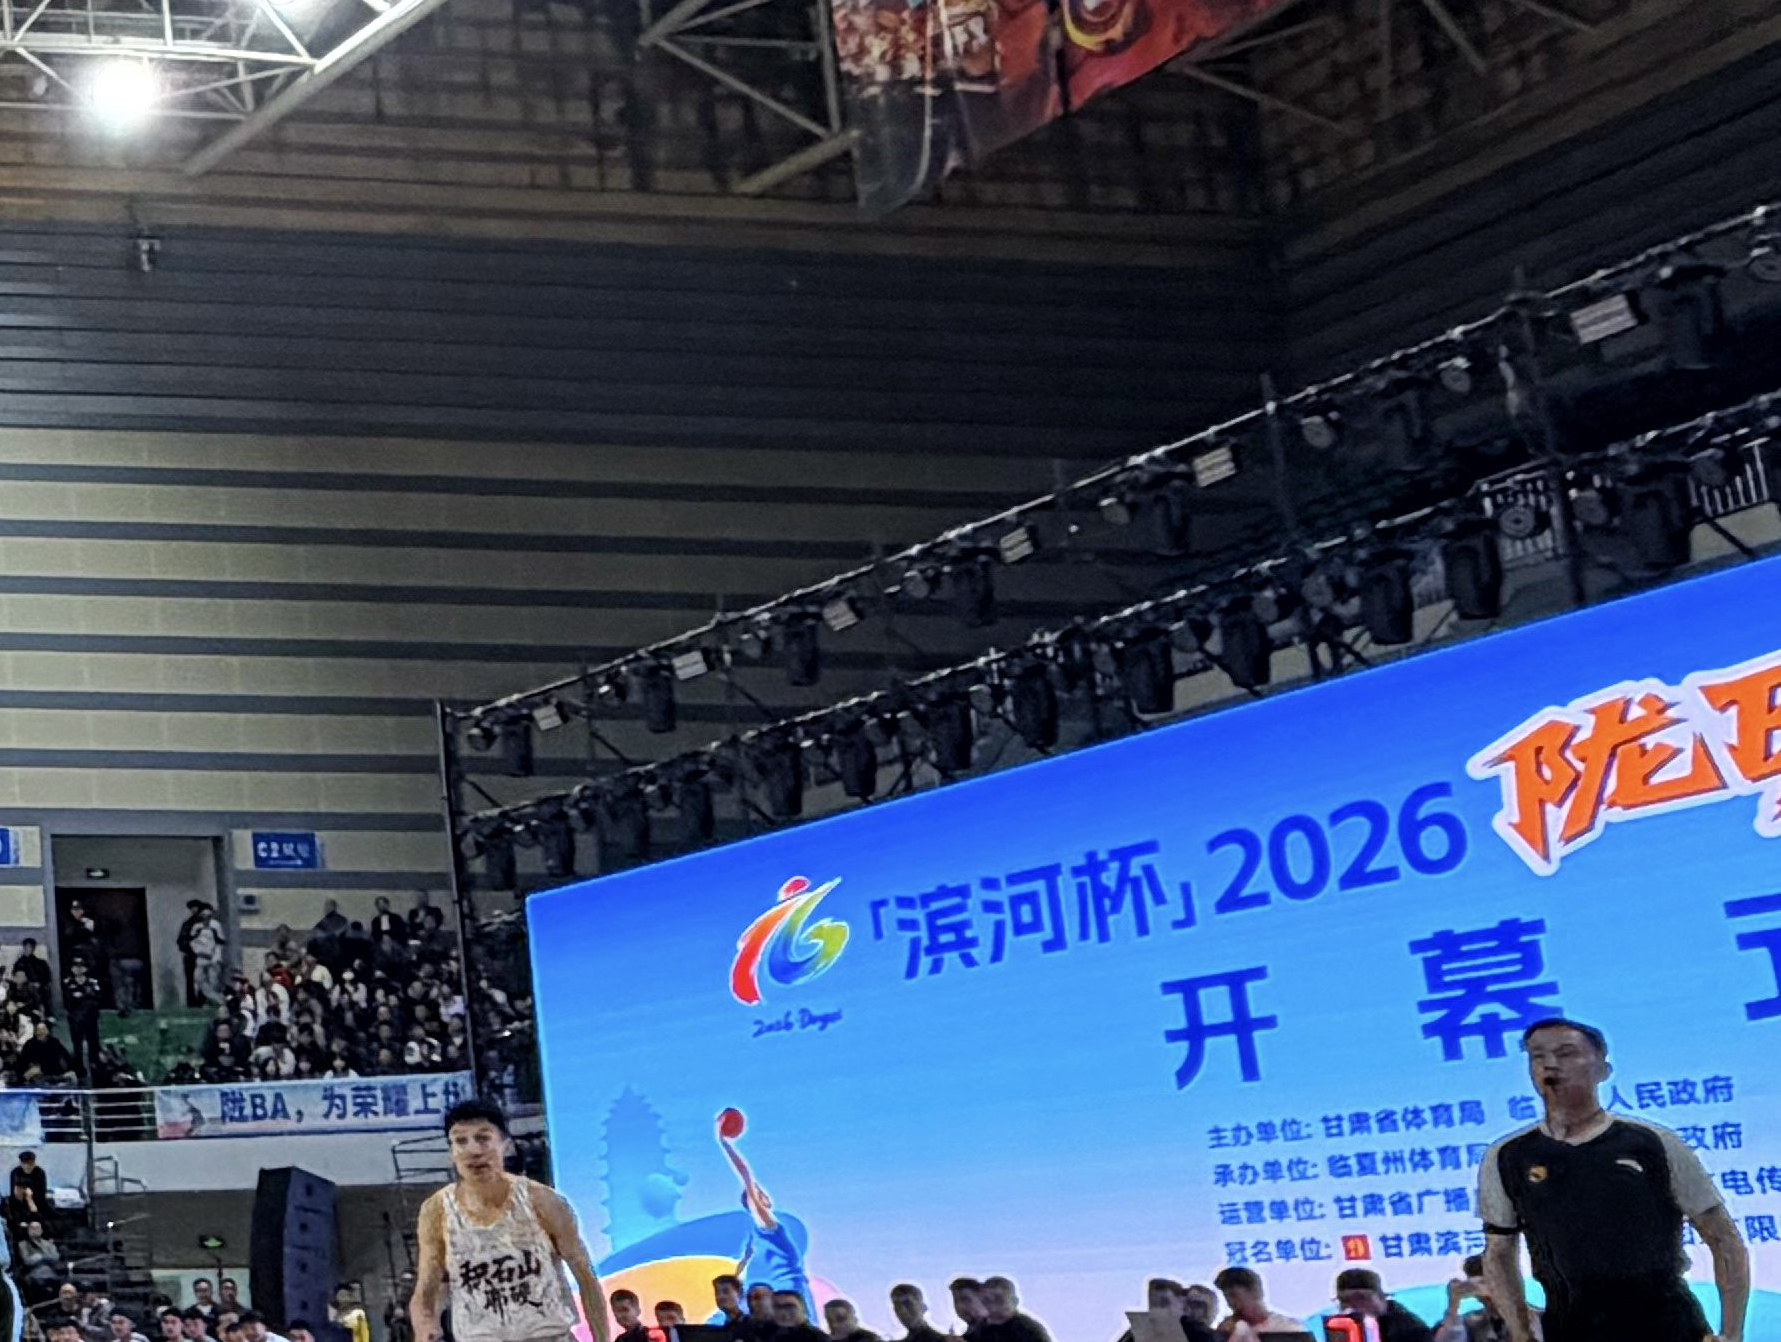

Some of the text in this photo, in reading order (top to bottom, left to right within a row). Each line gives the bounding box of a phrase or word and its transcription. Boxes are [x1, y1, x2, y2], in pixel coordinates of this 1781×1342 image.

[1320, 1099, 1486, 1138] 甘肃省体育局
